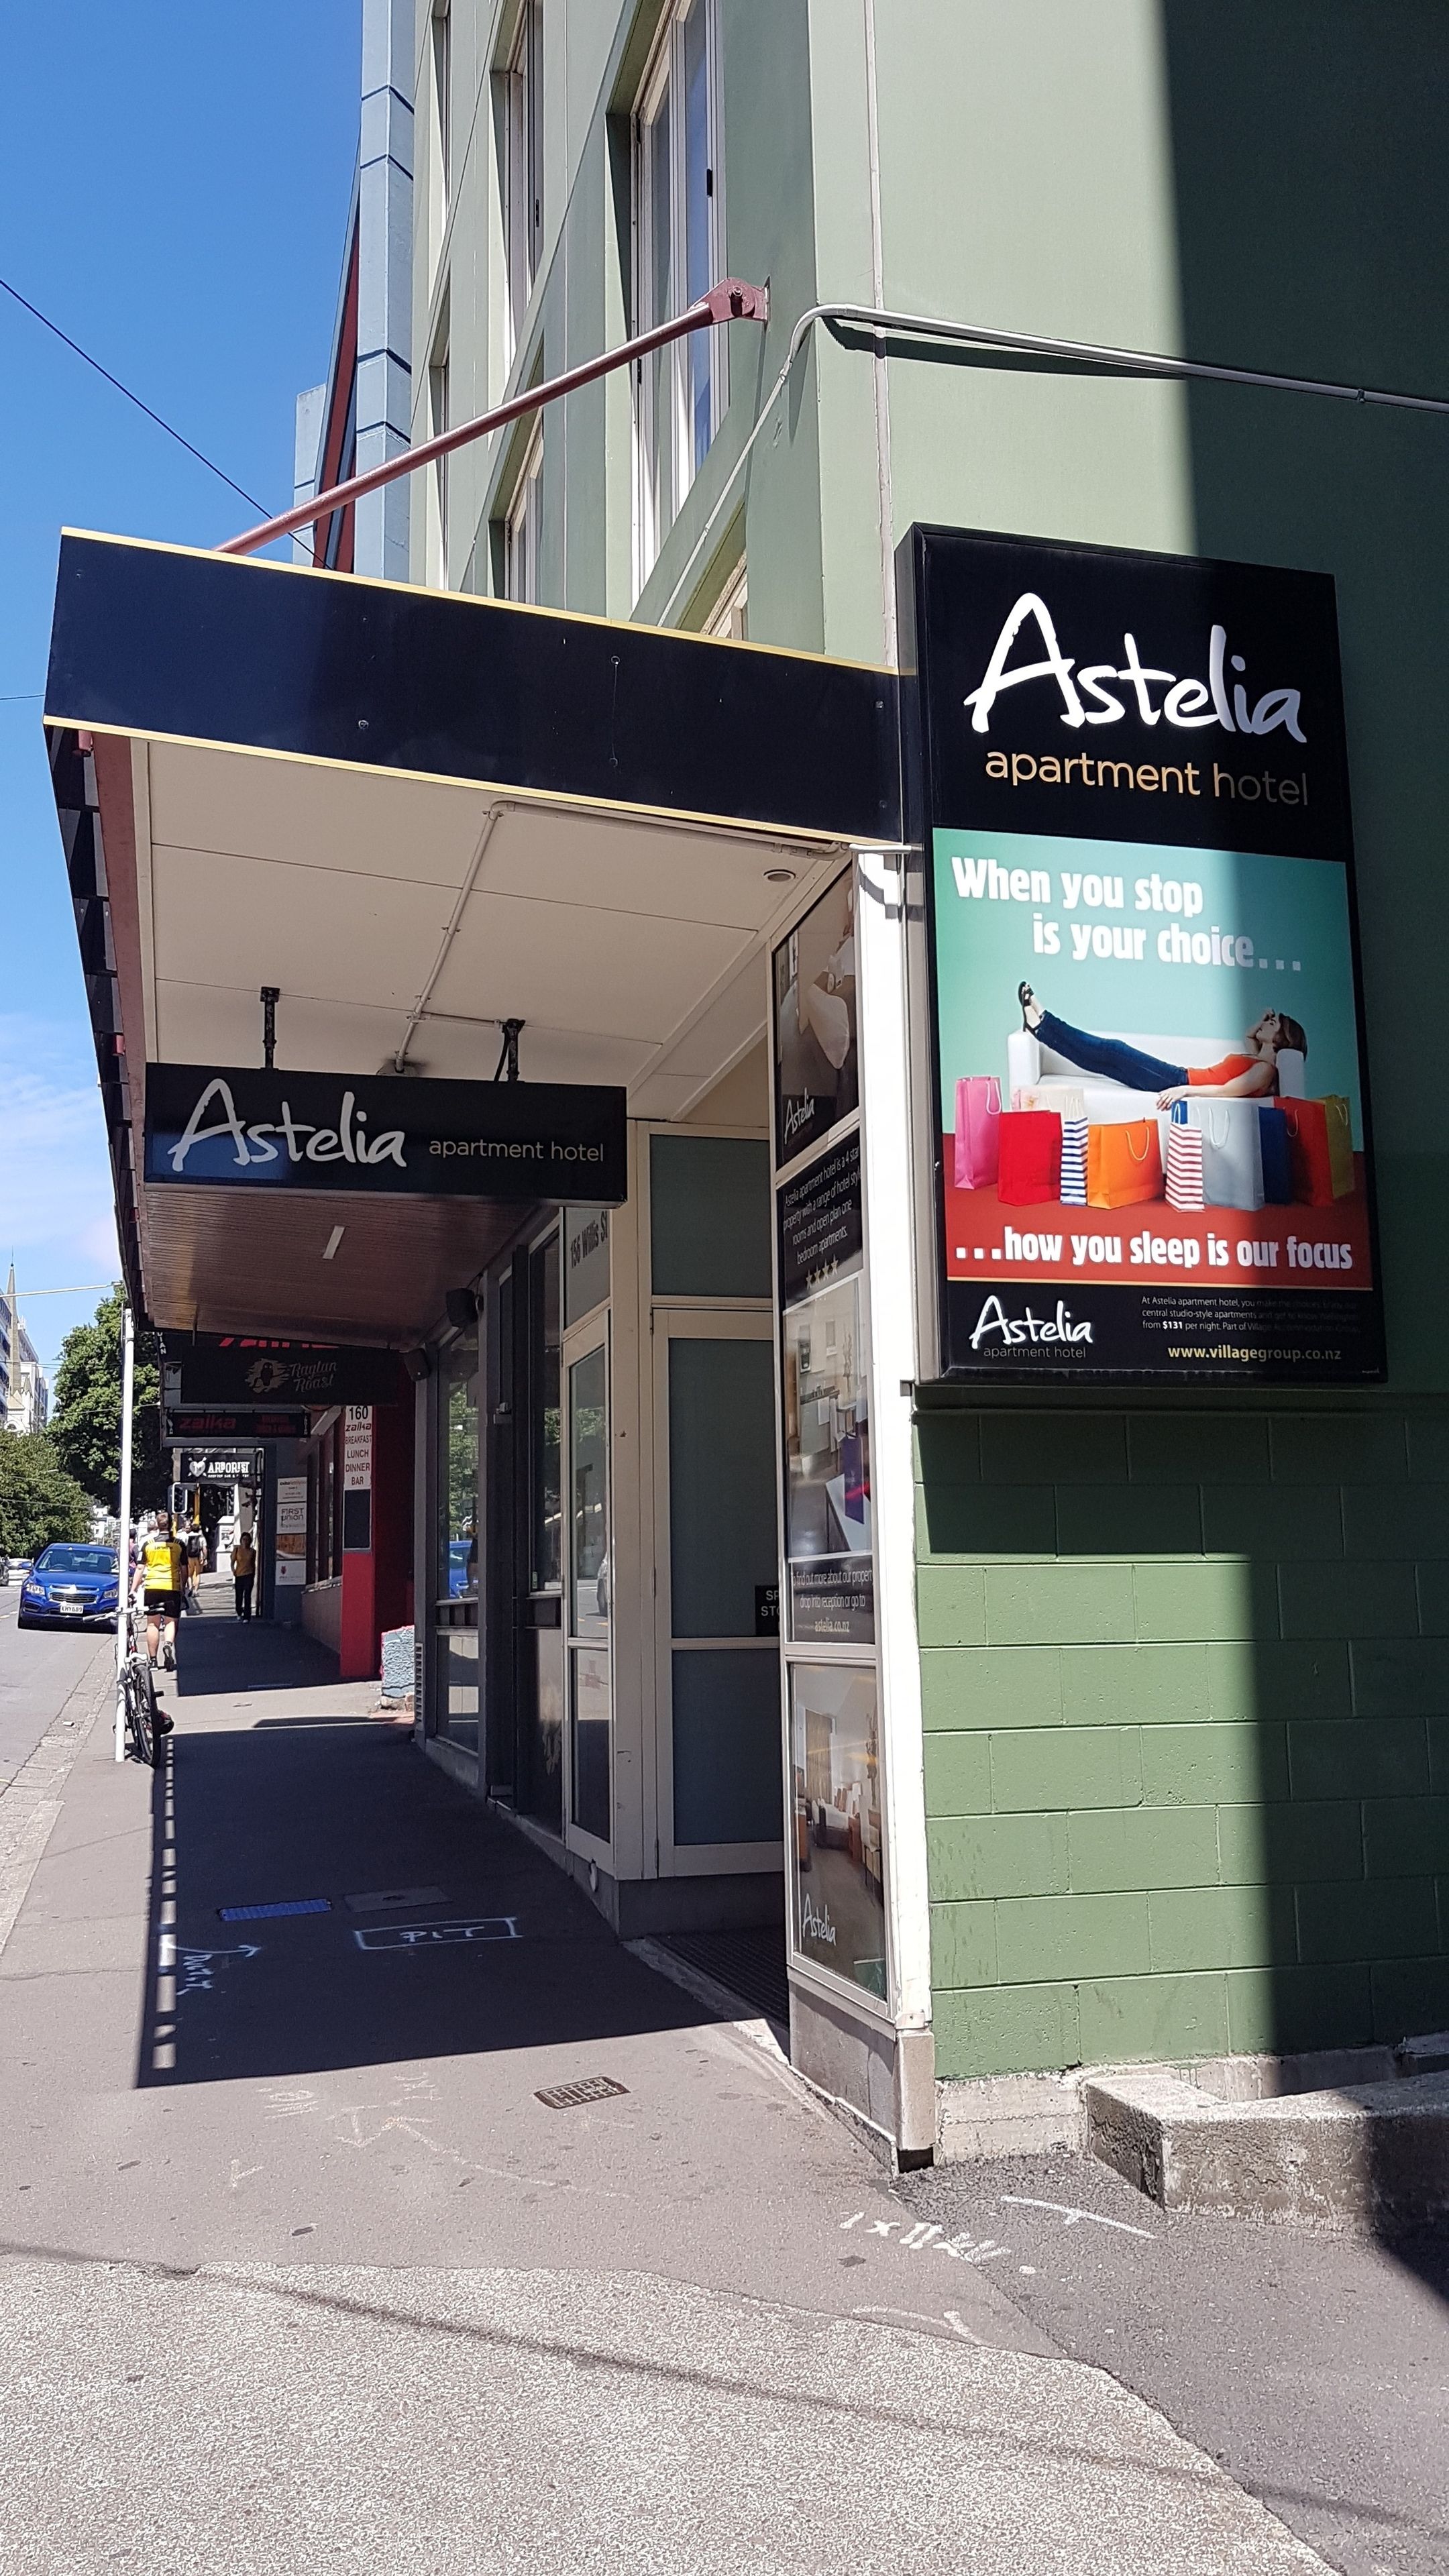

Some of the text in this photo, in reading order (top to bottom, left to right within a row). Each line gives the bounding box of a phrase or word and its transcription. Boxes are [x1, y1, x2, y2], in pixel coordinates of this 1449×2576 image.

[964, 592, 1307, 742] Astelia
[985, 751, 1307, 805] apartment hotel
[952, 856, 1203, 918] When you stop
[1032, 913, 1060, 954] is
[1071, 923, 1146, 961] your
[167, 1078, 407, 1172] Astelia
[784, 1087, 816, 1144] Astelia
[429, 1138, 604, 1162] apartment hotel
[799, 1171, 823, 1199] apartment
[823, 1159, 837, 1181] hotel
[837, 1173, 850, 1195] hotel
[792, 1229, 807, 1246] rooms
[816, 1212, 830, 1233] open
[830, 1203, 841, 1226] plan
[841, 1199, 853, 1215] one
[570, 1234, 580, 1269] 156
[797, 1243, 818, 1265] bedroom
[1071, 1234, 1122, 1265] you
[1130, 1230, 1199, 1269] sleep
[1208, 1233, 1229, 1267] is
[1237, 1240, 1277, 1267] our
[1287, 1236, 1353, 1269] focus
[1141, 1297, 1150, 1305] At
[1152, 1297, 1176, 1305] Astelia
[1177, 1298, 1217, 1307] apartment
[1219, 1298, 1240, 1307] hotel,
[1241, 1299, 1255, 1308] you
[1170, 1309, 1212, 1320] studio-style
[1214, 1310, 1256, 1319] apartments
[969, 1295, 1093, 1349] Astelia
[1142, 1321, 1161, 1329] from
[1163, 1320, 1183, 1330] $131
[1199, 1322, 1221, 1332] night.
[1222, 1322, 1237, 1330] Part
[1238, 1322, 1246, 1330] of
[983, 1346, 1086, 1359] apartment hotel
[1167, 1344, 1342, 1362] www.villagegroup.co.nz
[349, 1405, 369, 1420] 160
[344, 1434, 372, 1444] BREAKFAST
[347, 1449, 369, 1458] LUNCH
[345, 1462, 370, 1472] DINNER
[352, 1476, 364, 1485] BAR
[802, 1893, 837, 1946] Astelia
